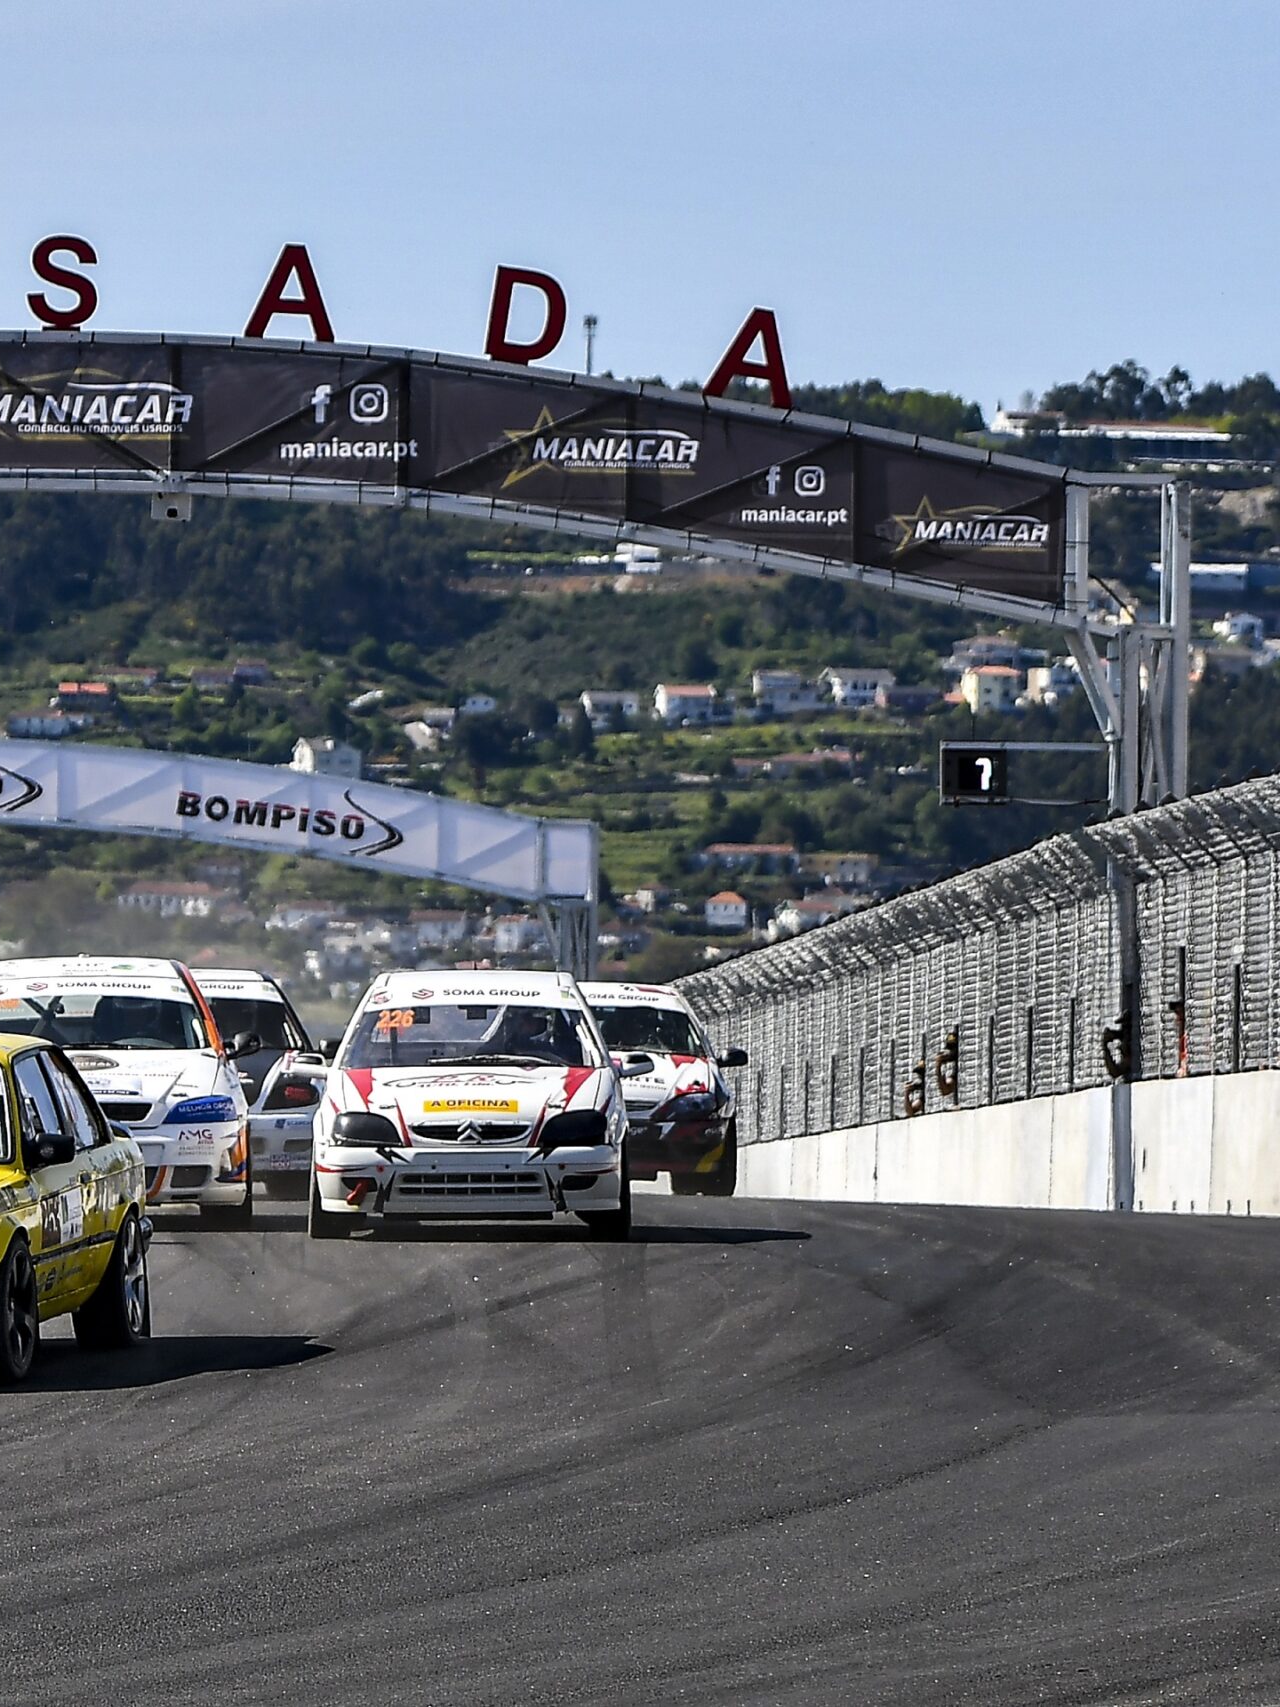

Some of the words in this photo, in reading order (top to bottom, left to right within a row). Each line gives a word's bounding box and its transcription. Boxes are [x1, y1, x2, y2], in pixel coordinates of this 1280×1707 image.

[141, 424, 183, 433] USADOS
[280, 435, 418, 461] maniacar.pt
[532, 436, 701, 463] MANIACAR
[741, 506, 847, 526] maniacar.pt
[914, 520, 1050, 542] MANIACAR
[176, 790, 365, 840] BOMPISO
[101, 982, 151, 990] GROUP
[199, 983, 245, 991] GROUP
[443, 988, 484, 997] SOMA
[489, 988, 541, 998] GROUP
[584, 992, 615, 1000] OMA
[617, 994, 660, 1002] GROUP
[375, 1009, 415, 1029] 226
[446, 1099, 510, 1108] OFICINA
